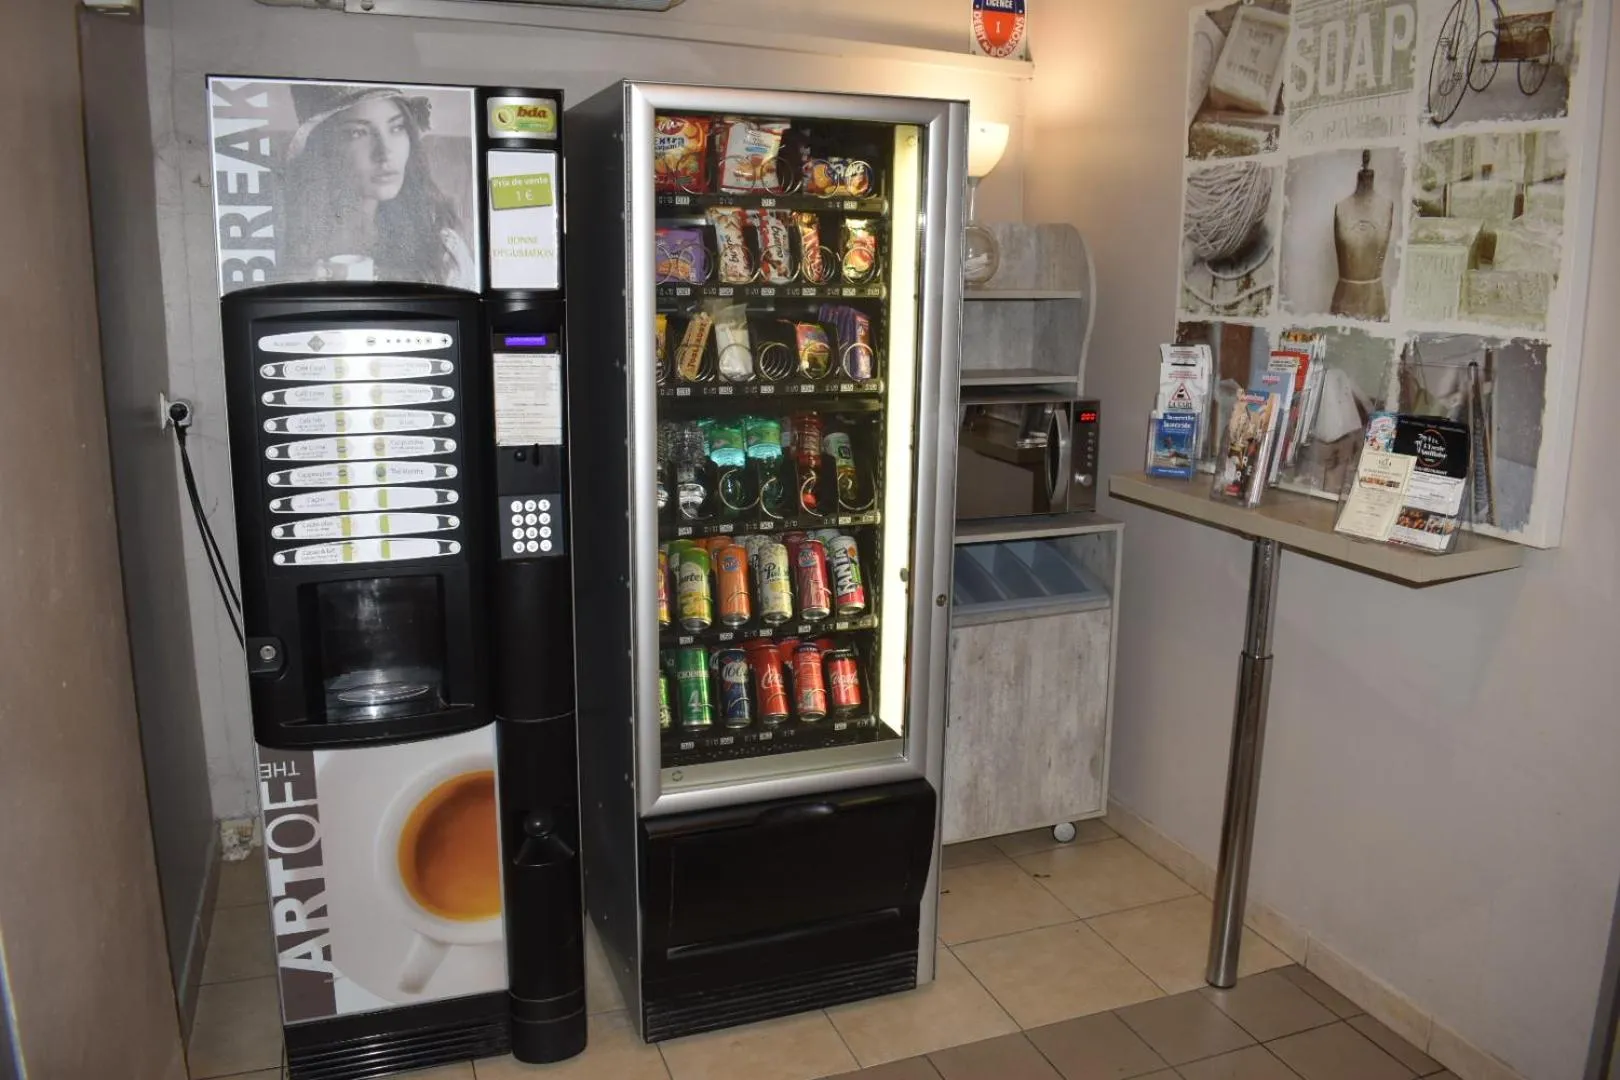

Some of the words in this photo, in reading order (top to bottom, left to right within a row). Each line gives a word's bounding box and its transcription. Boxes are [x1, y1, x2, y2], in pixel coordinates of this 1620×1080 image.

[991, 16, 1025, 57] BOISSONS
[1287, 3, 1415, 102] SOAP
[517, 106, 547, 119] bda
[213, 80, 276, 286] BREAK
[259, 760, 299, 780] THE
[260, 781, 321, 854] OF
[268, 857, 340, 980] ART
